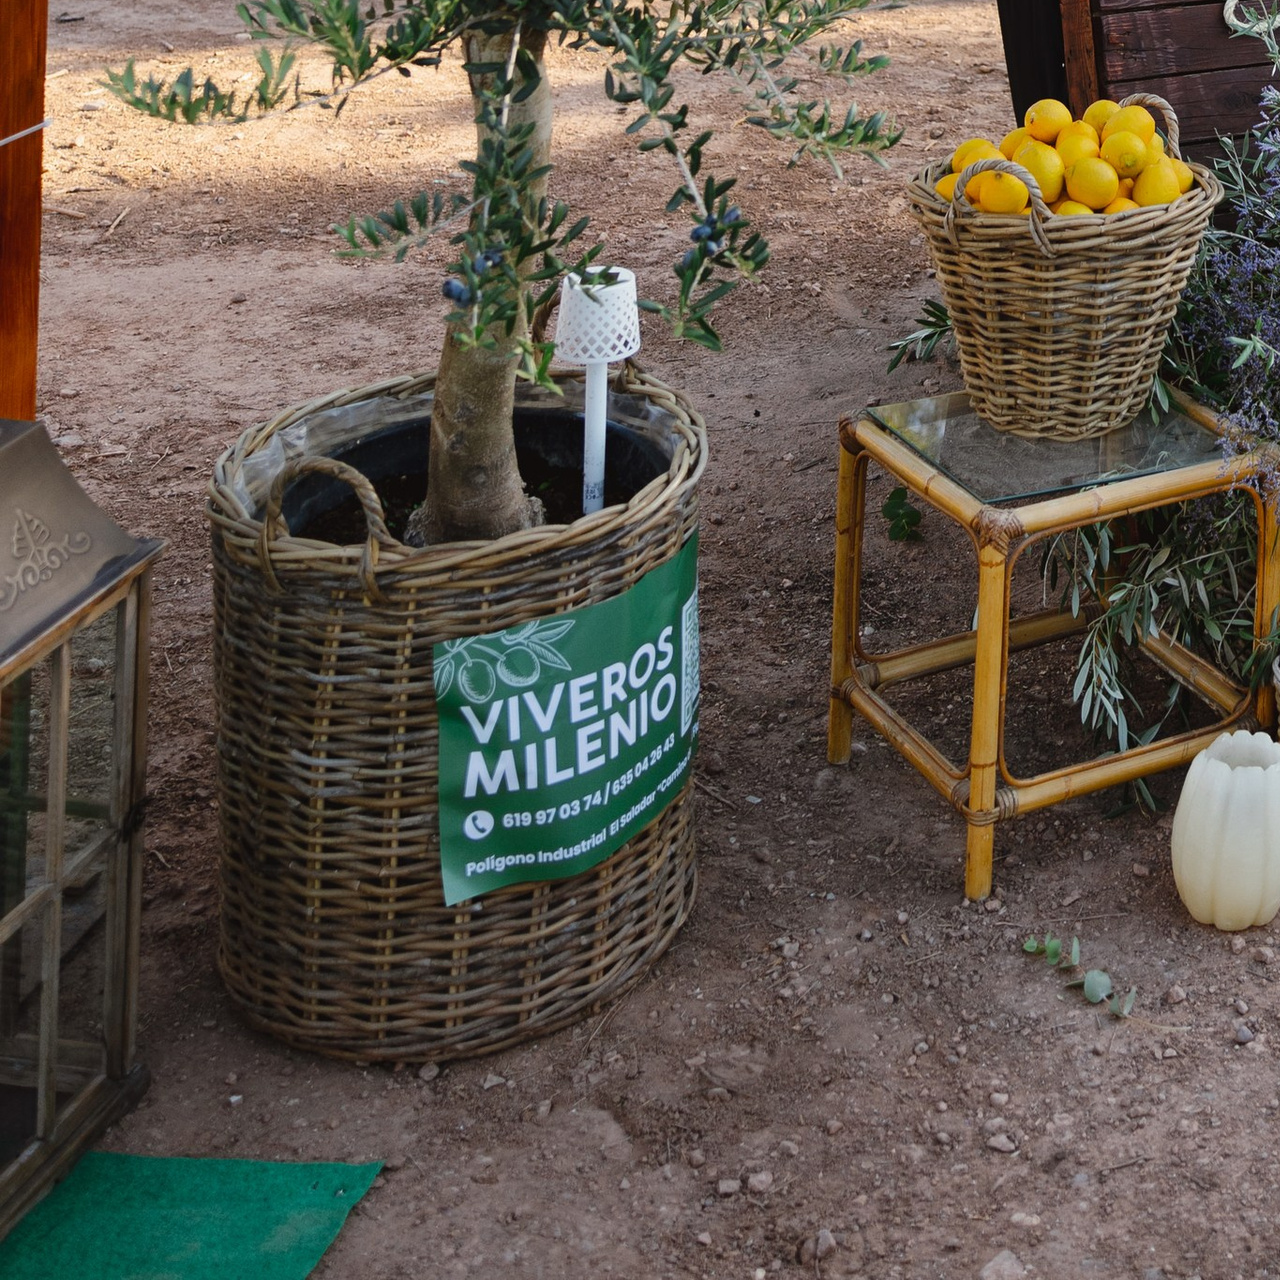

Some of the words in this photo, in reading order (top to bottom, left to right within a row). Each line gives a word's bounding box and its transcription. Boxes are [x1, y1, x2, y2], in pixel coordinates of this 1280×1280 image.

[459, 625, 674, 745] VIVEROS
[463, 672, 677, 798] MILENIO
[465, 853, 536, 877] Polígono
[538, 827, 607, 863] Industrial
[609, 818, 620, 836] El
[620, 790, 656, 828] Saladar
[502, 811, 532, 828] 619
[535, 807, 557, 825] 97
[559, 799, 581, 819] 03
[583, 789, 602, 812] 74
[612, 768, 634, 796] 635
[634, 755, 649, 778] 04
[649, 744, 663, 766] 26
[663, 732, 675, 753] 43
